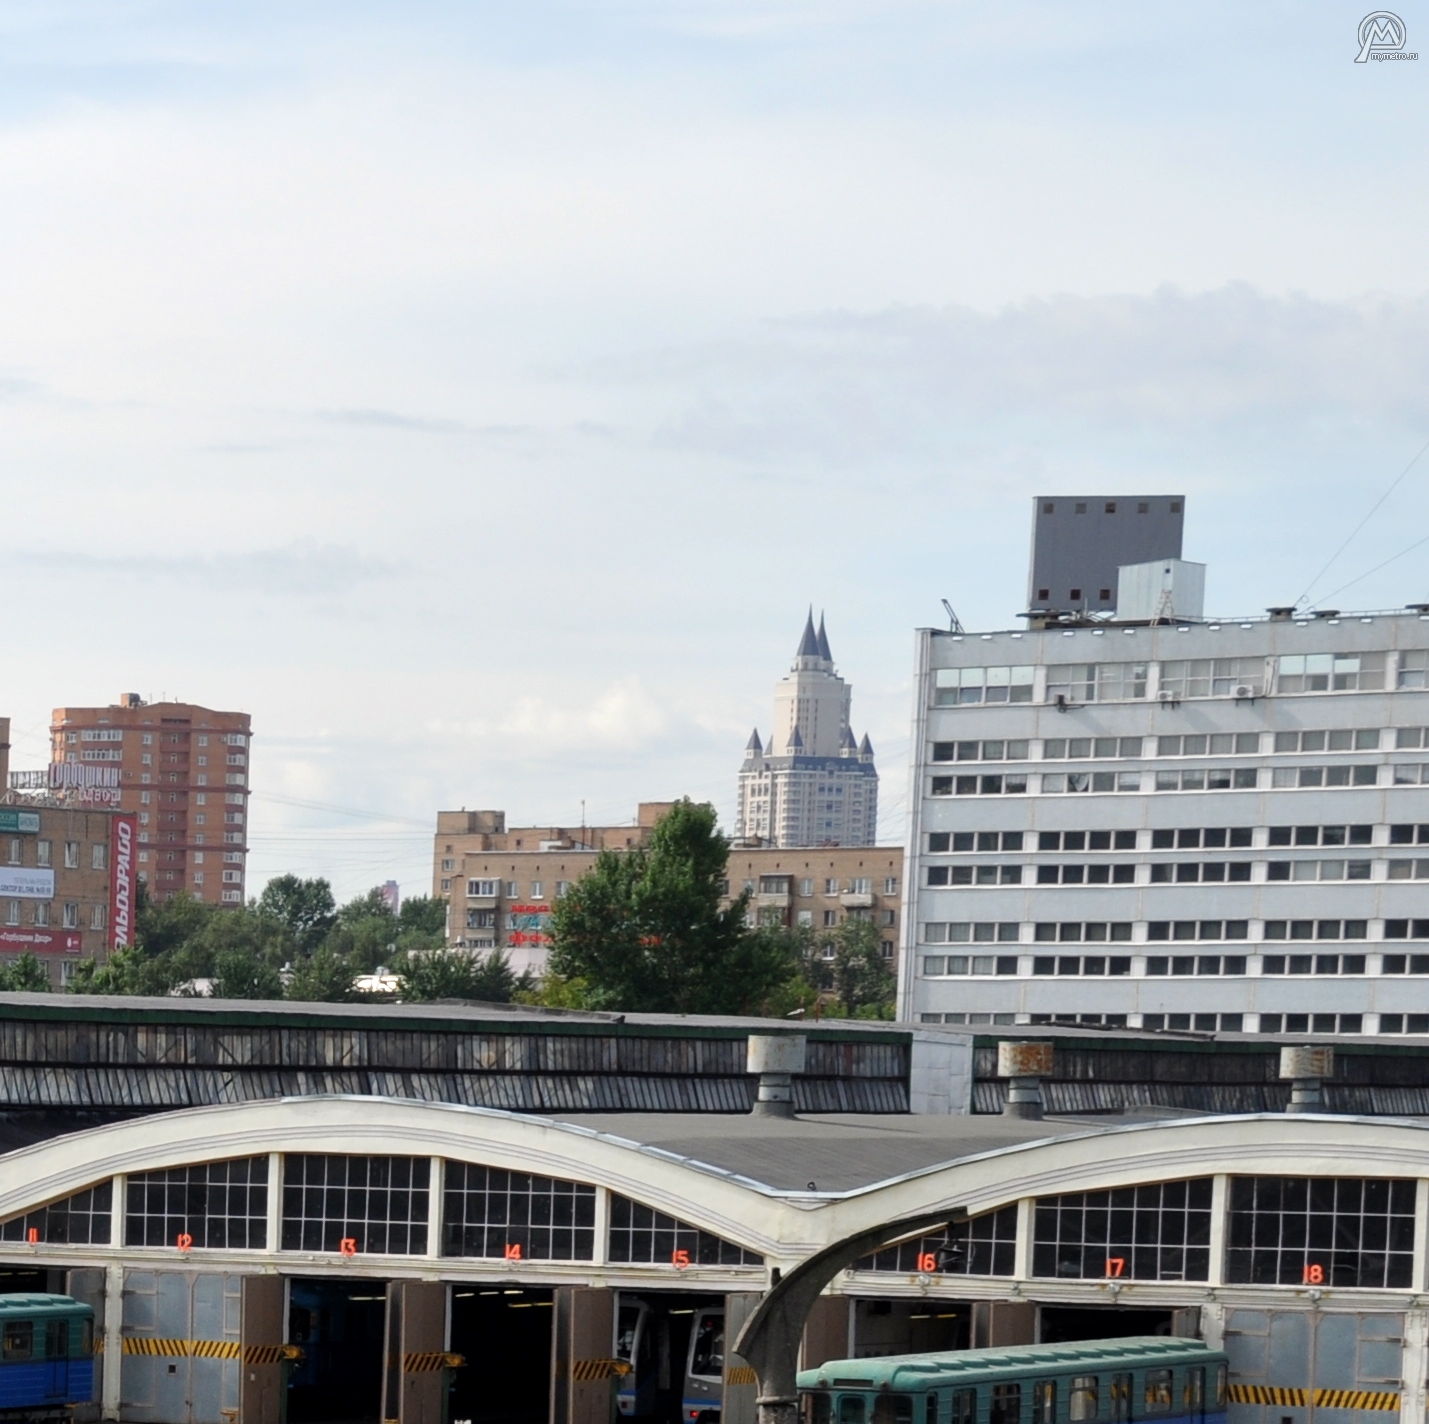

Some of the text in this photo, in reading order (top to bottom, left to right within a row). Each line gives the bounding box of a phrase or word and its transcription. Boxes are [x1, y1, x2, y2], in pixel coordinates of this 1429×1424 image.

[28, 1229, 38, 1244] 11
[178, 1234, 192, 1251] 12
[341, 1239, 356, 1256] 13
[506, 1245, 521, 1260] 14
[673, 1251, 690, 1267] 15
[918, 1254, 936, 1271] 16
[1107, 1259, 1124, 1275] 17
[1304, 1265, 1322, 1283] 18
